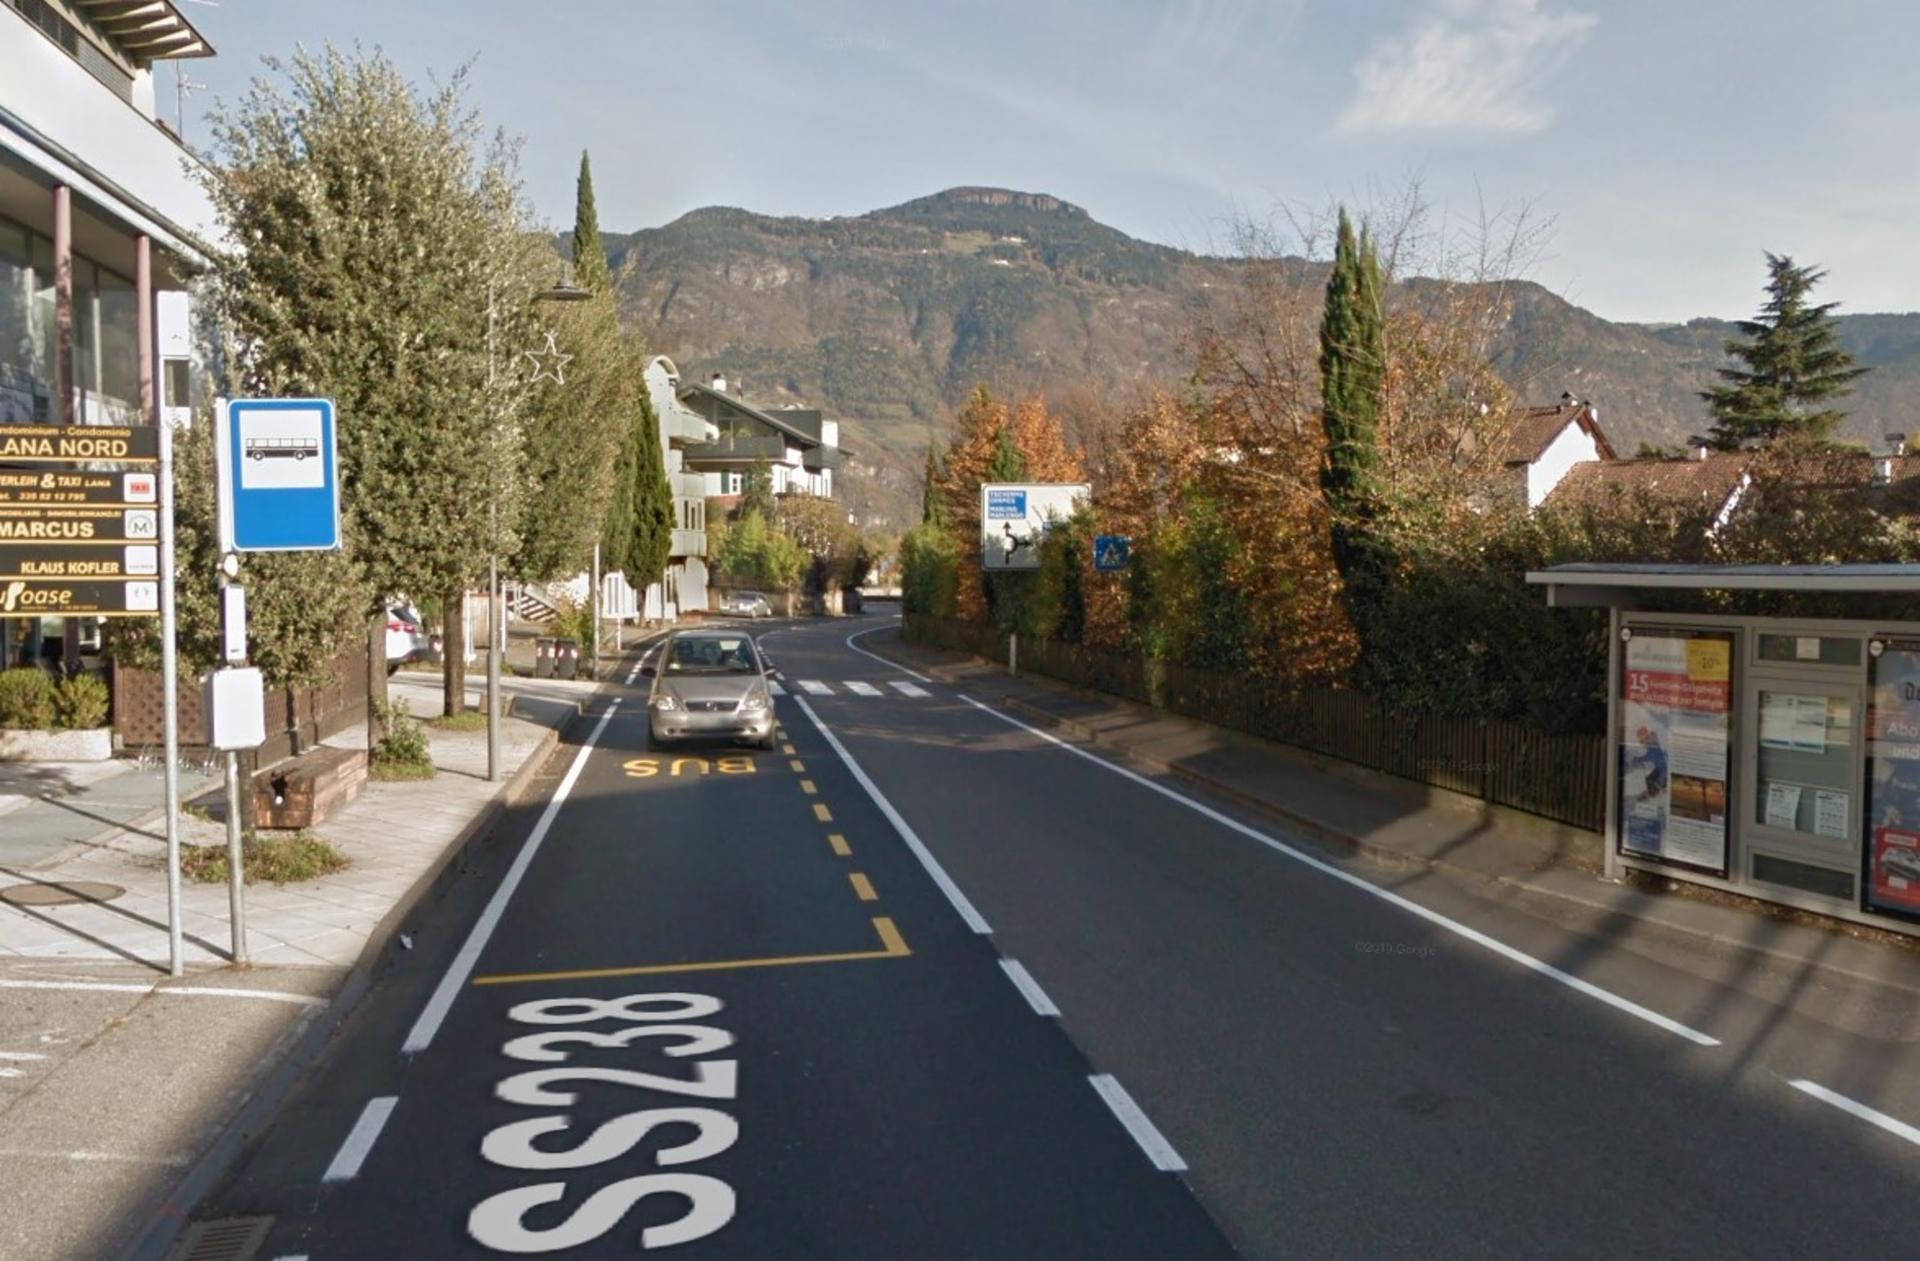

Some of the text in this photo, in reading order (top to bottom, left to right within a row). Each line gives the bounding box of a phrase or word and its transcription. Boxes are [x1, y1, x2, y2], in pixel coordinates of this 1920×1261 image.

[60, 438, 128, 457] NORD
[0, 475, 38, 487] ERLEIH
[40, 472, 56, 489] &
[57, 476, 83, 487] TAXI
[0, 521, 95, 538] MARCUS
[21, 561, 65, 574] KLAUS
[67, 562, 120, 575] KOFLER
[1629, 673, 1649, 693] 15
[622, 756, 757, 777] BUS
[467, 992, 739, 1254] SS238
